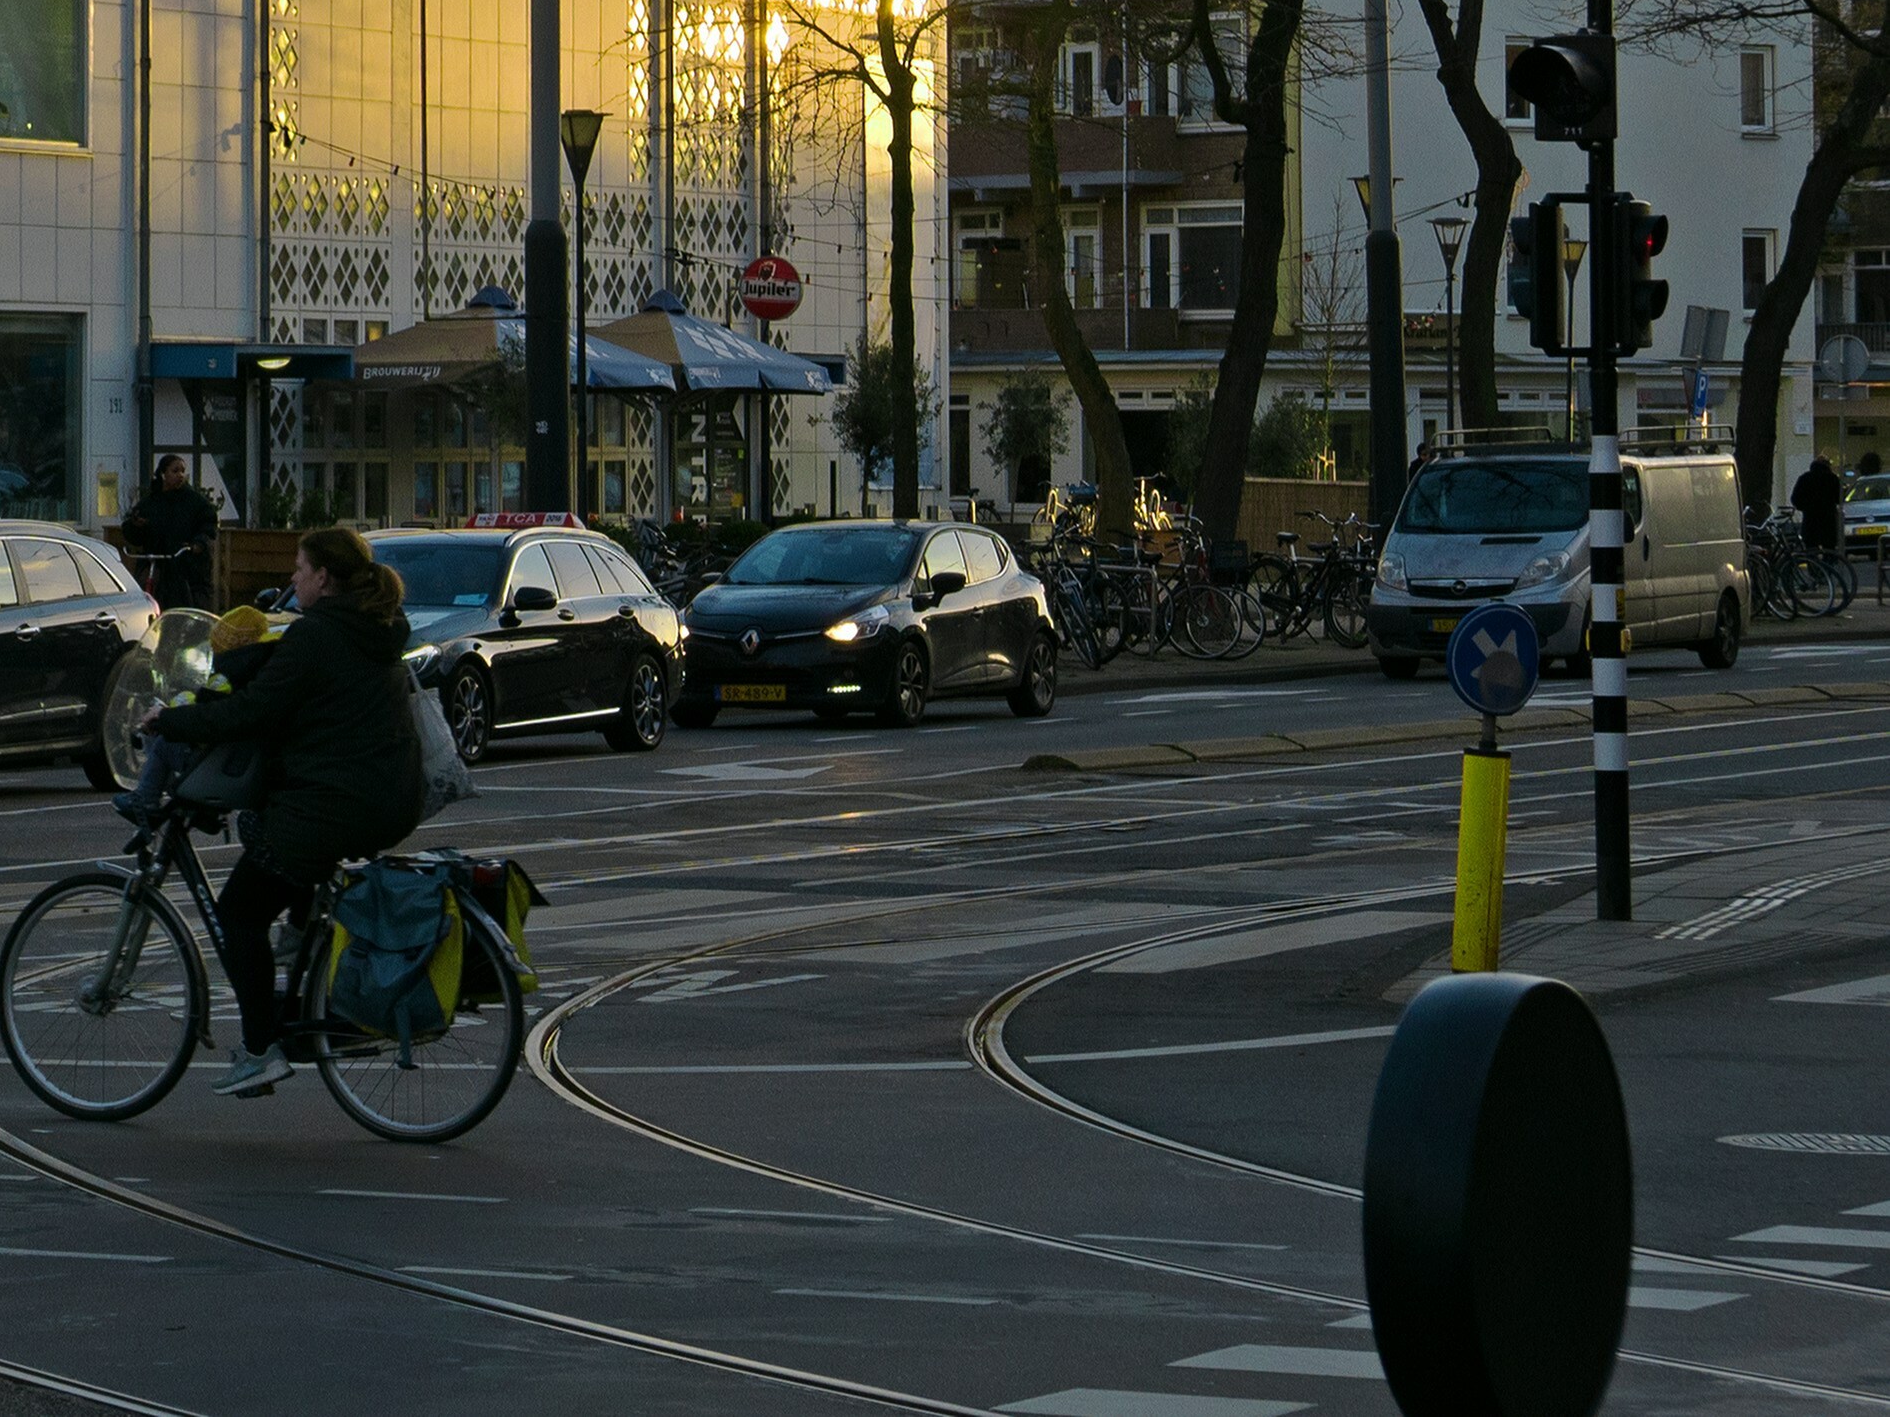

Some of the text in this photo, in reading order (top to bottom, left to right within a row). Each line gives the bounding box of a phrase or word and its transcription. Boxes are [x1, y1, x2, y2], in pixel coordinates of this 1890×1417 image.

[743, 280, 796, 299] Jupiler
[1697, 375, 1707, 400] P
[505, 513, 537, 524] TCA
